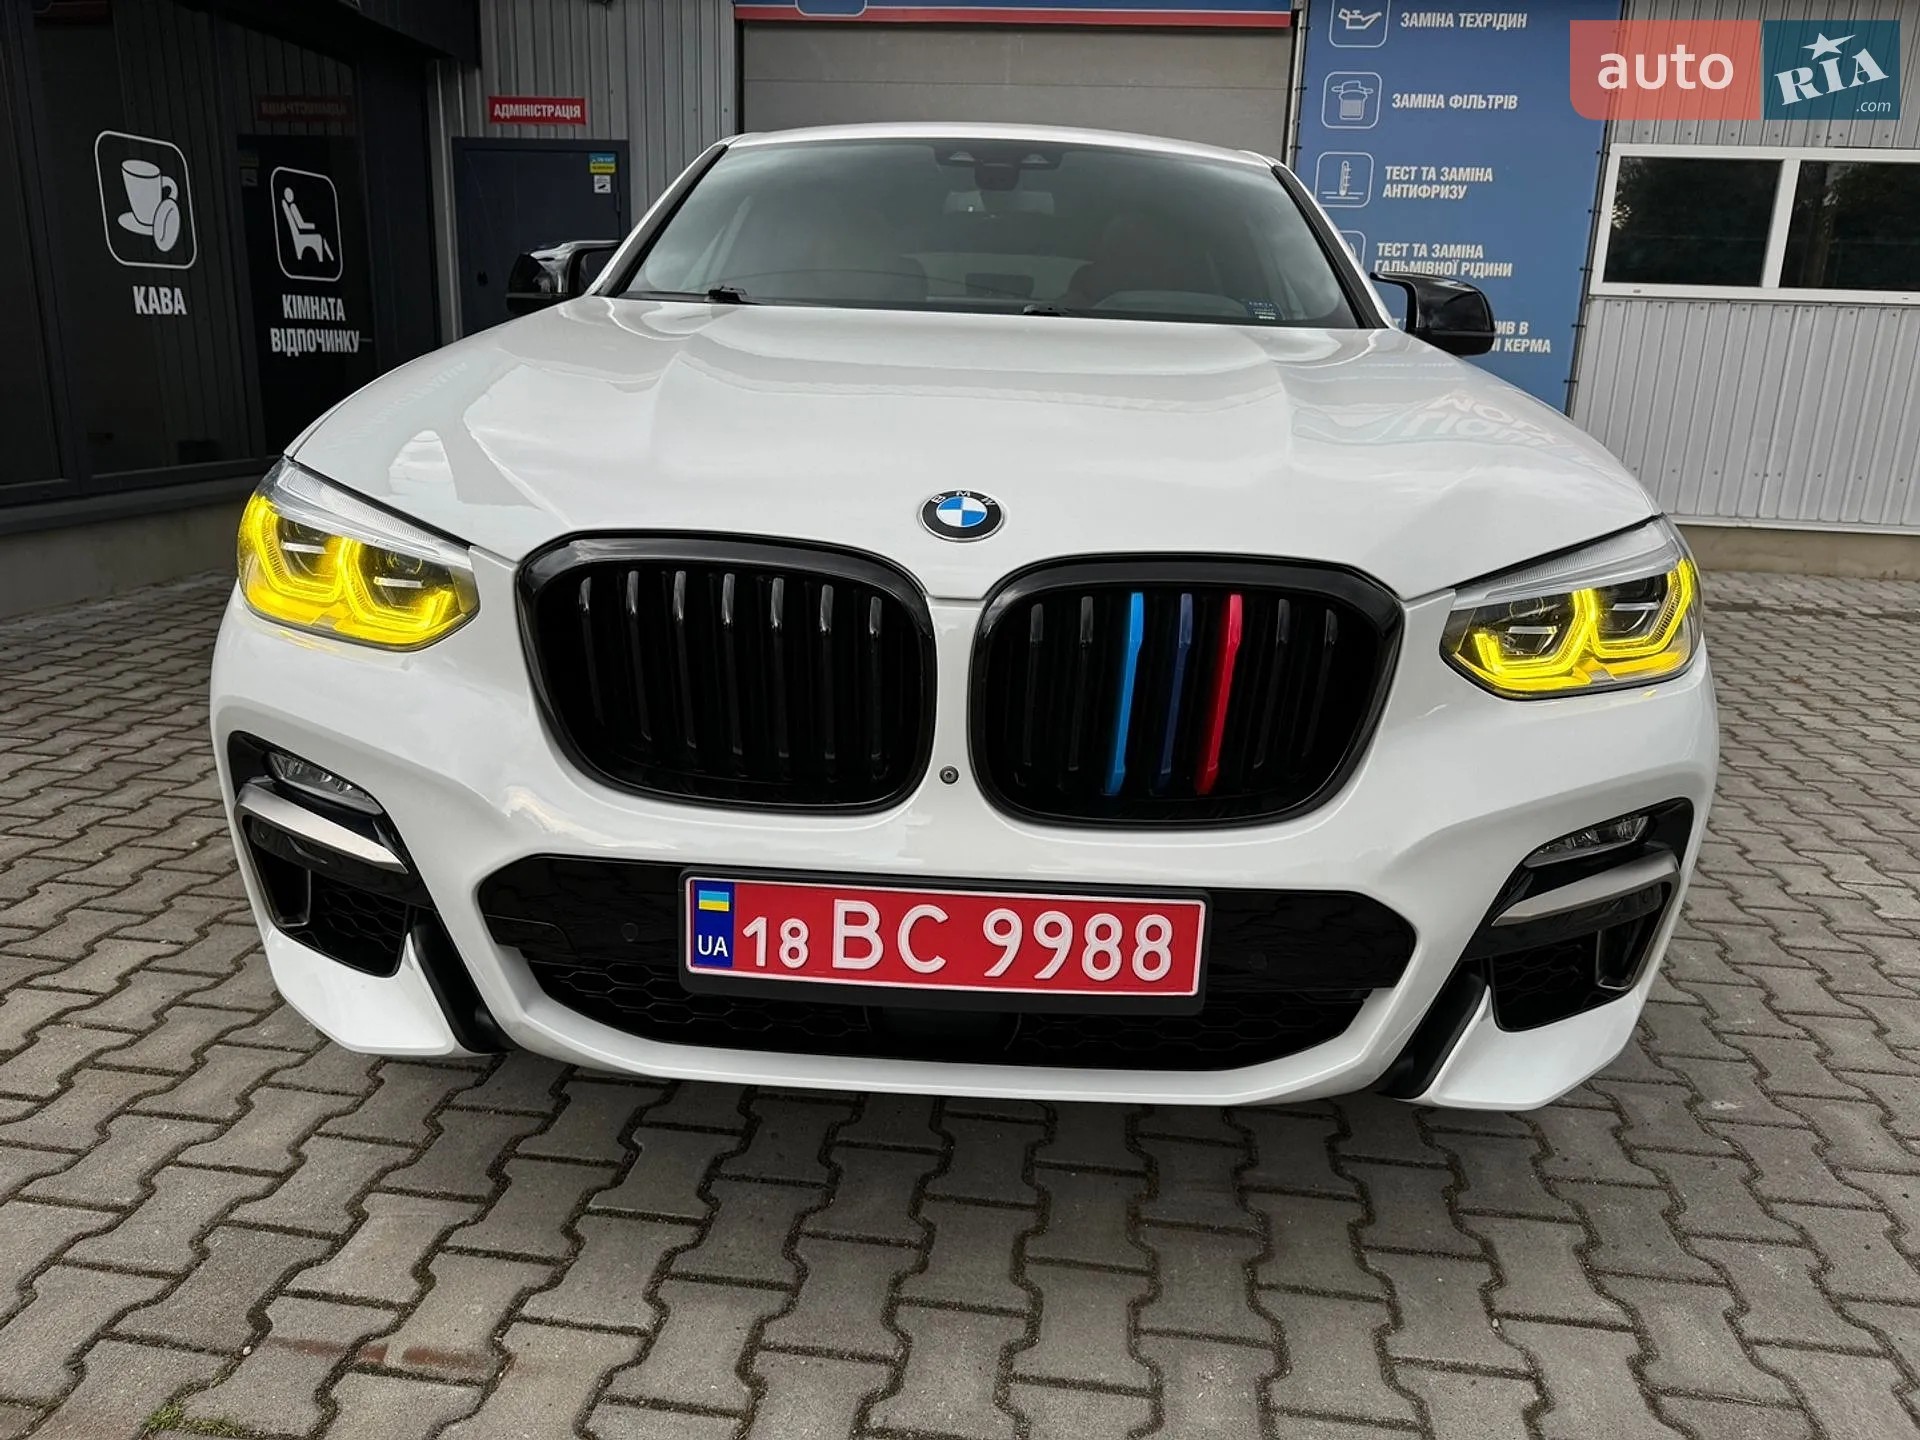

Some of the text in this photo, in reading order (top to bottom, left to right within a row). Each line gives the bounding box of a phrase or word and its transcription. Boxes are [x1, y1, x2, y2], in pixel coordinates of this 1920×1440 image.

[1400, 12, 1528, 31] ЗАМІНА ТЕХРІДИН
[1391, 92, 1519, 110] ЗАМІНА ФІЛЬТРІВ
[494, 103, 582, 120] АДМІНІСТРАЦІЯ
[1384, 165, 1494, 182] ТЕСТ ТА ЗАМІНА
[1382, 183, 1468, 200] АНТИФРИЗУ
[1377, 242, 1484, 259] ТЕСТ ТА ЗАМІНА
[1374, 258, 1513, 279] ГАЛЬМІВНОЇ РІДИНИ
[132, 285, 188, 316] КАВА
[282, 294, 346, 322] КІМНАТА
[1518, 321, 1529, 336] В
[270, 327, 360, 358] ВІДПОЧИНКУ
[1503, 337, 1552, 353] КЕРМА
[931, 489, 996, 506] BMW
[698, 934, 728, 957] UA
[742, 898, 1174, 982] 18 BC 9988
